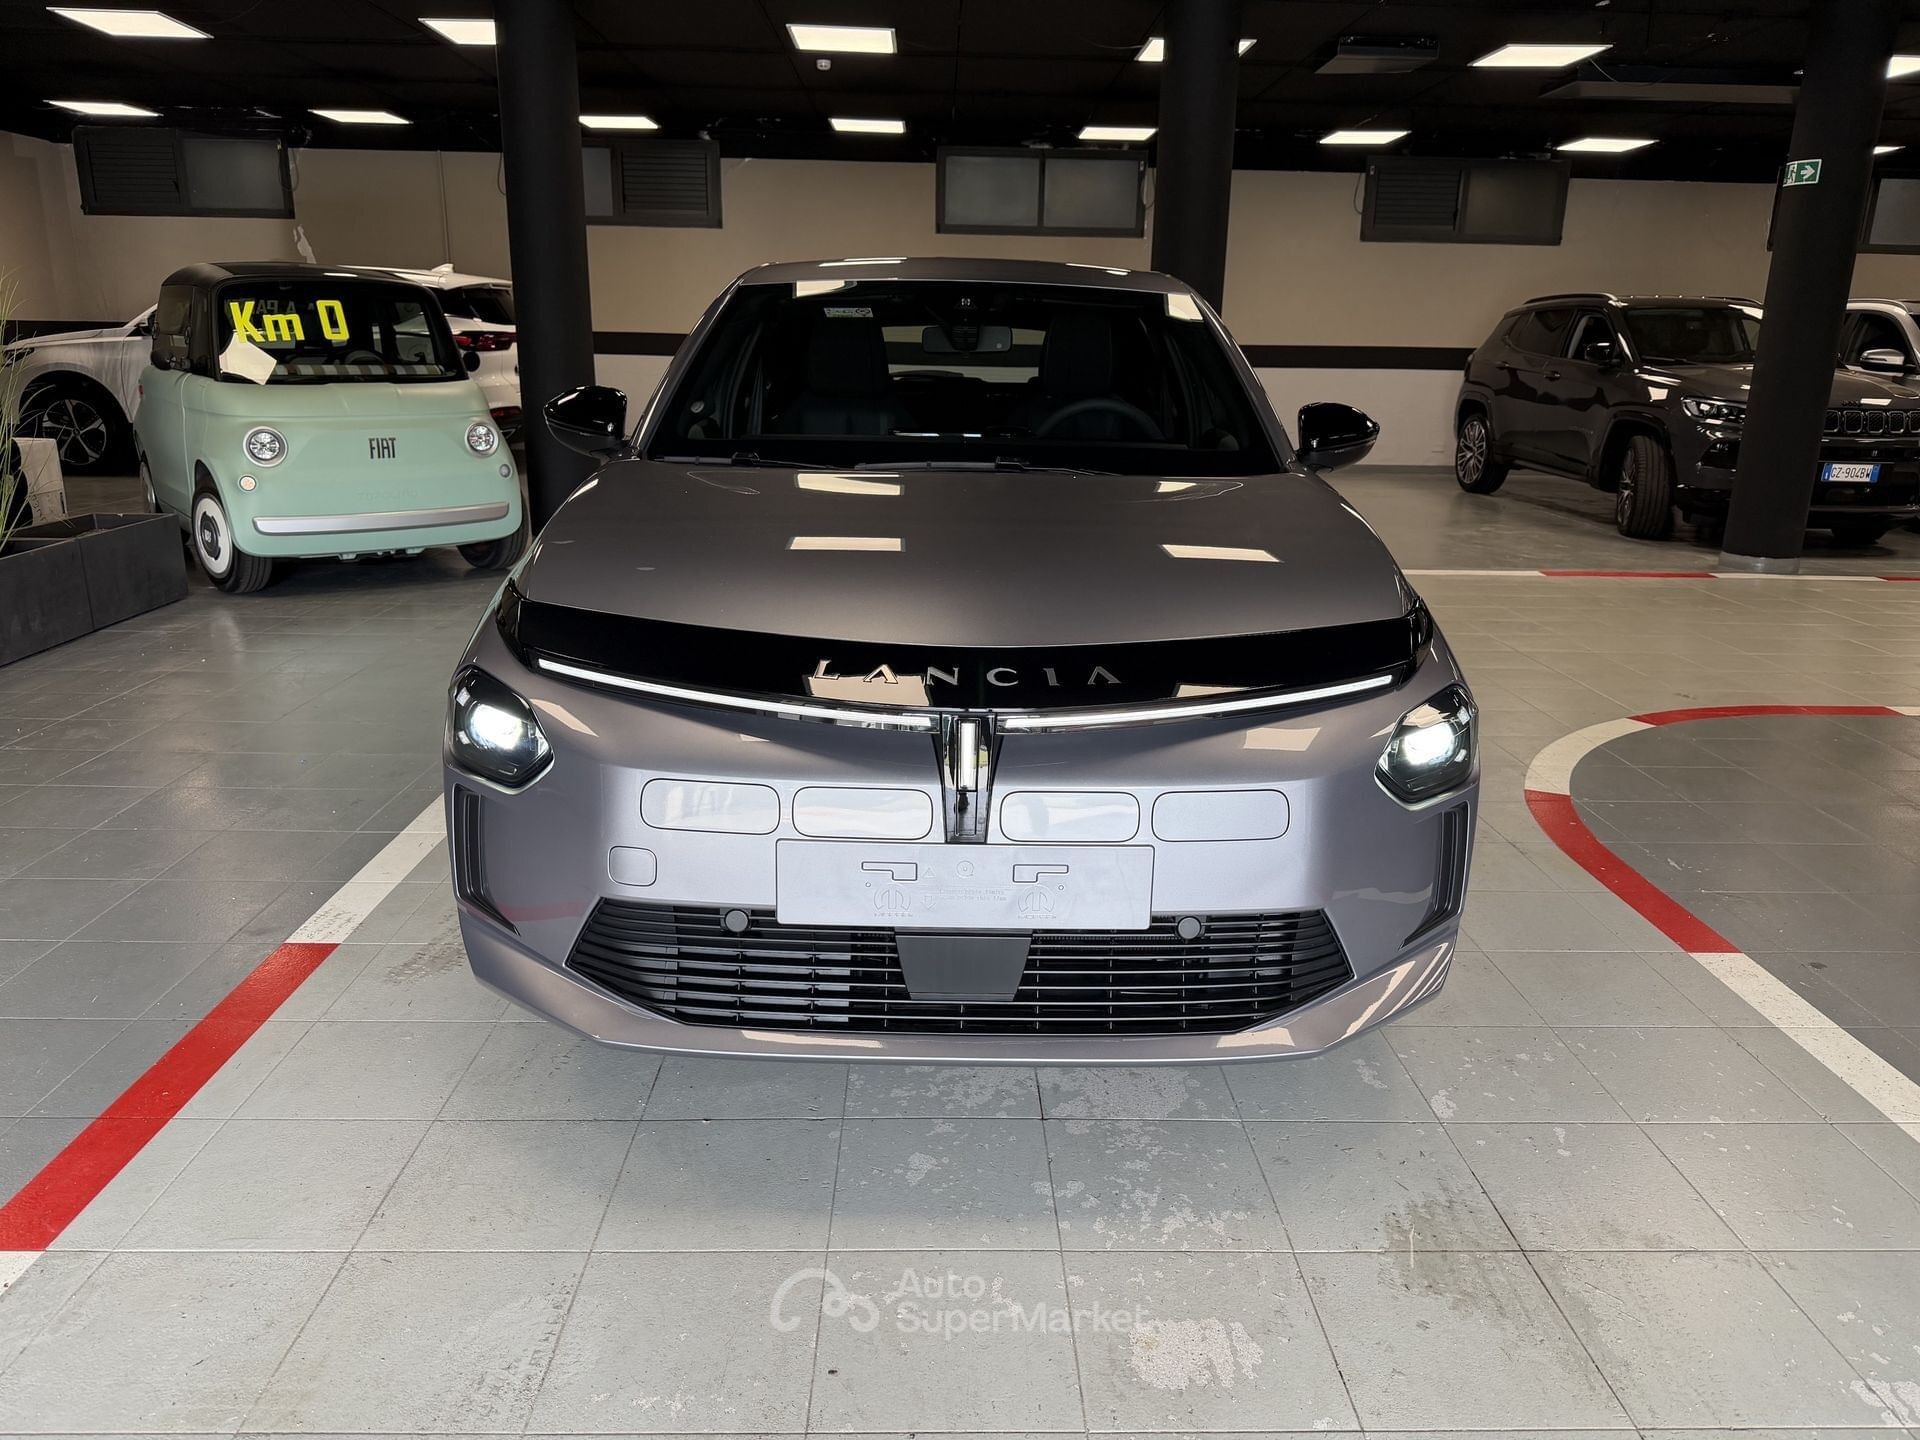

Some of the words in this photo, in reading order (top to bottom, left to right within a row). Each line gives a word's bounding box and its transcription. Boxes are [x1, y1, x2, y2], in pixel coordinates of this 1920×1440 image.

[230, 301, 305, 343] Km
[316, 300, 350, 340] 0
[368, 437, 396, 459] FIAT
[812, 658, 1123, 687] LANCIA
